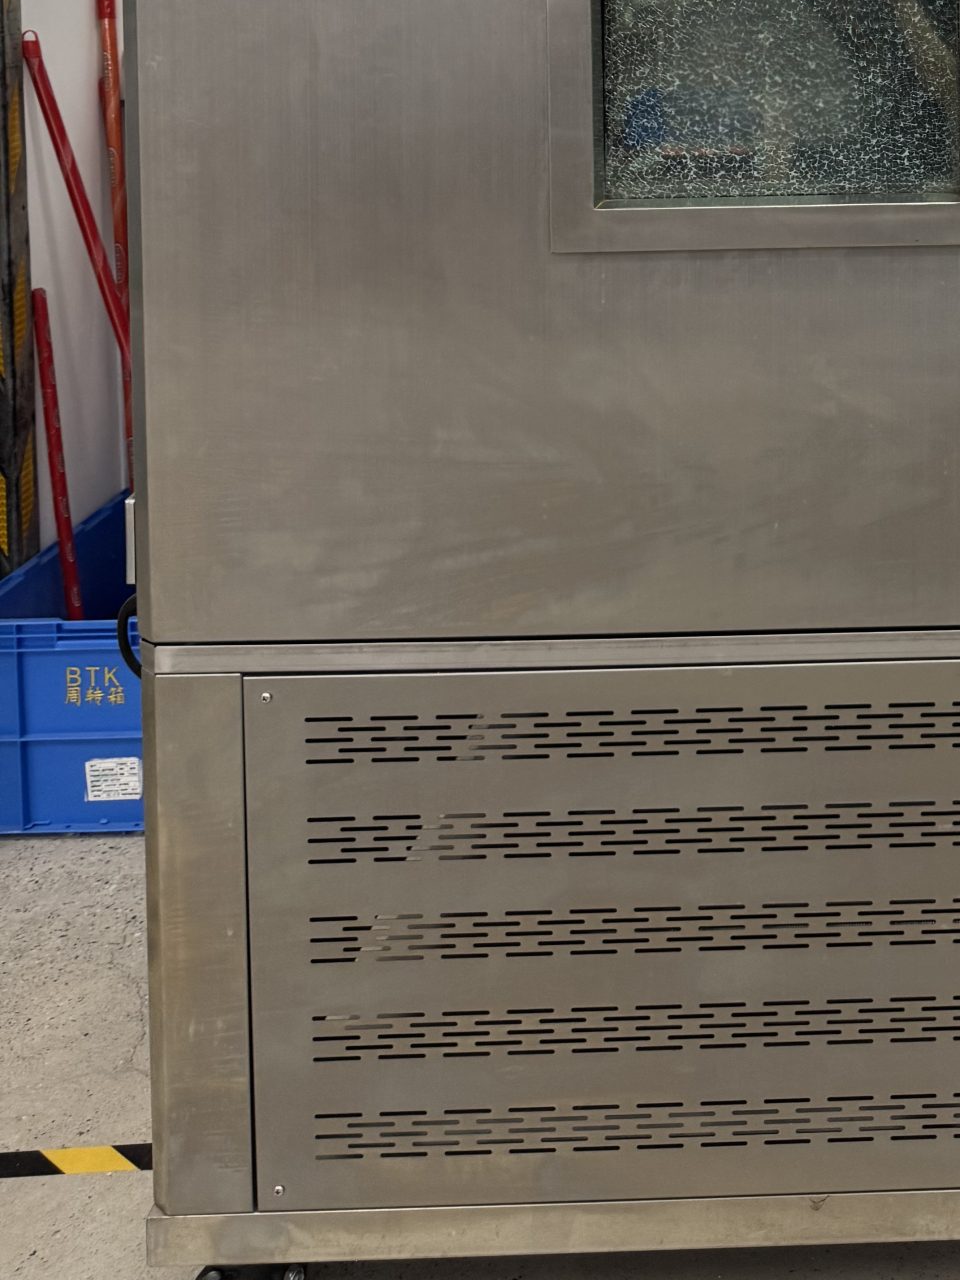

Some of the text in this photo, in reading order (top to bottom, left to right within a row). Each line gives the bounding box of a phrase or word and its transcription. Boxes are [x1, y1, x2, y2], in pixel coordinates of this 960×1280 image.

[66, 666, 120, 686] BTK
[65, 687, 124, 706] 周转箱
